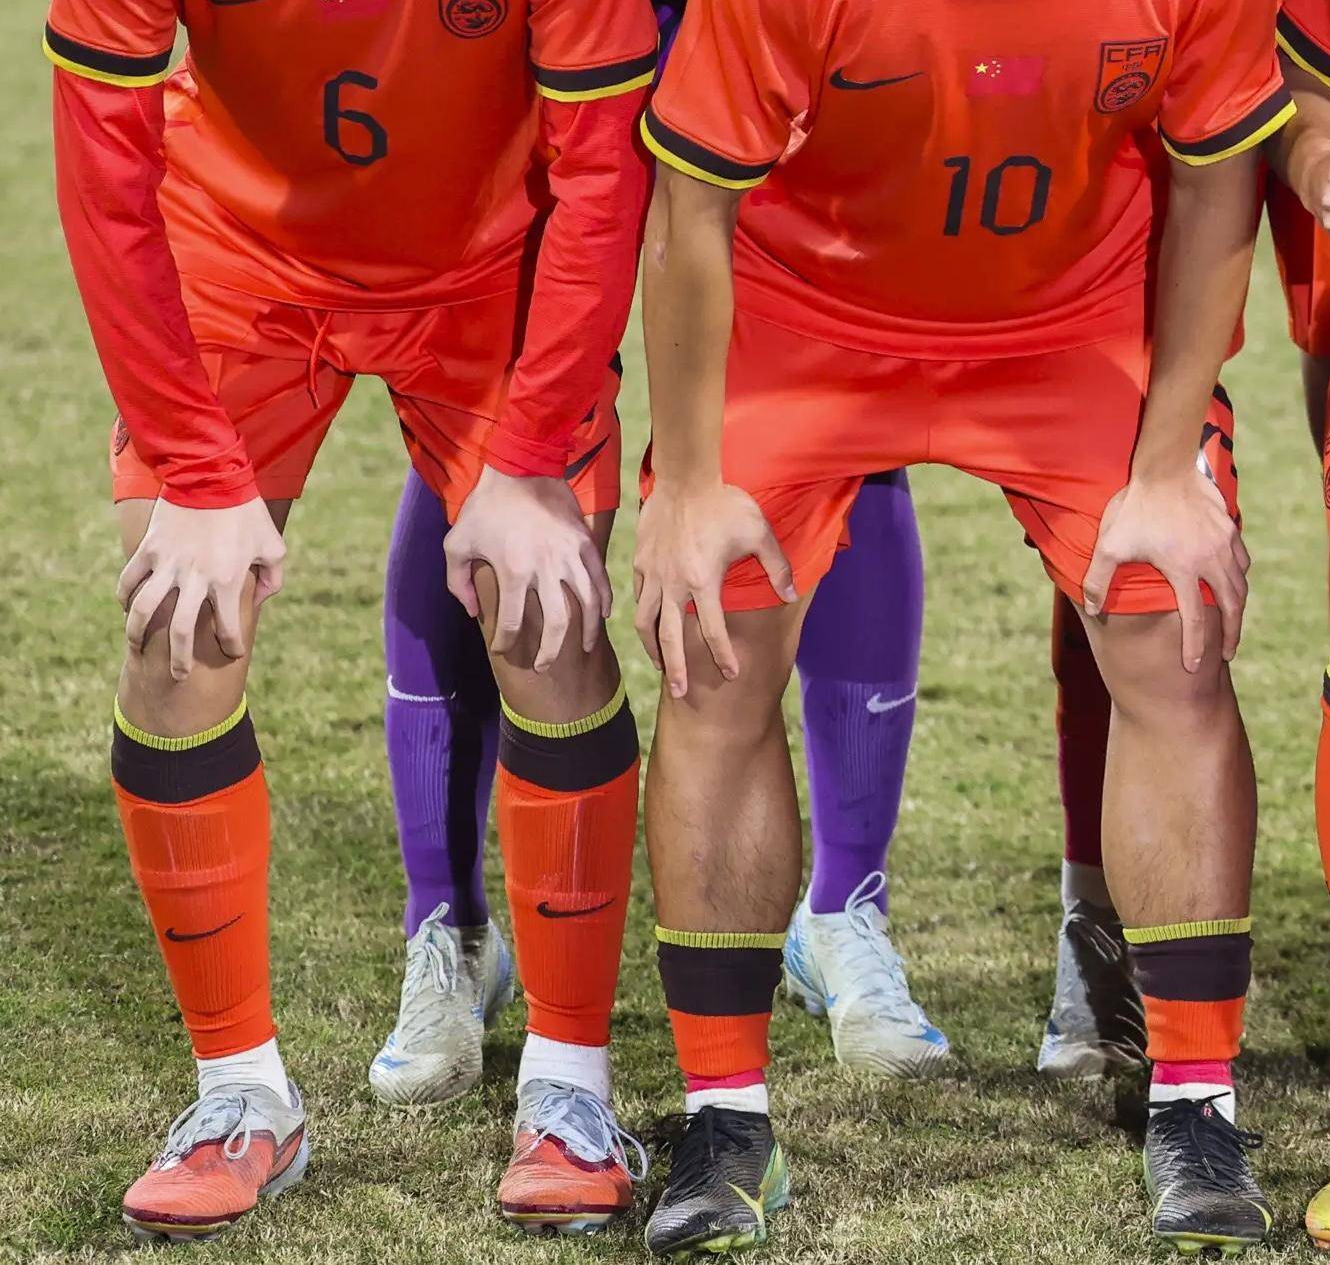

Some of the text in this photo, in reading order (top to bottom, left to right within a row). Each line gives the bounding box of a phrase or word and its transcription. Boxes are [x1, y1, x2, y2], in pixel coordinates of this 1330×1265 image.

[1106, 45, 1160, 63] CFA
[324, 70, 388, 166] 6
[943, 155, 1052, 236] 10
